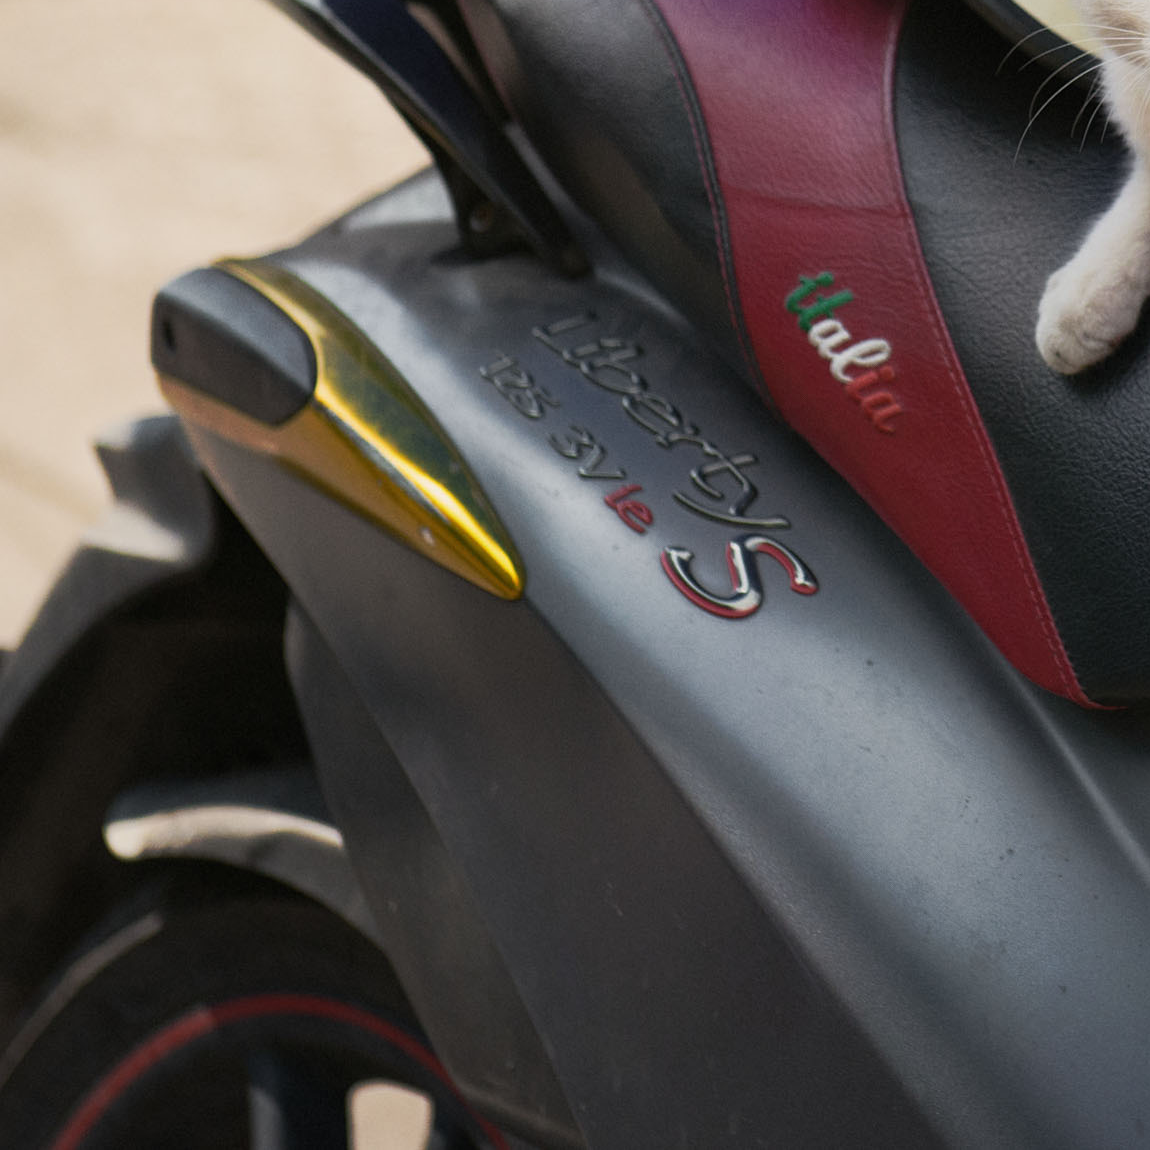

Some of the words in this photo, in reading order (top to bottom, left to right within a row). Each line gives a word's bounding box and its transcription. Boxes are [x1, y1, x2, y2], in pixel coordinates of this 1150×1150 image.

[479, 354, 560, 418] 125
[531, 310, 791, 528] Liberty
[660, 533, 818, 619] S
